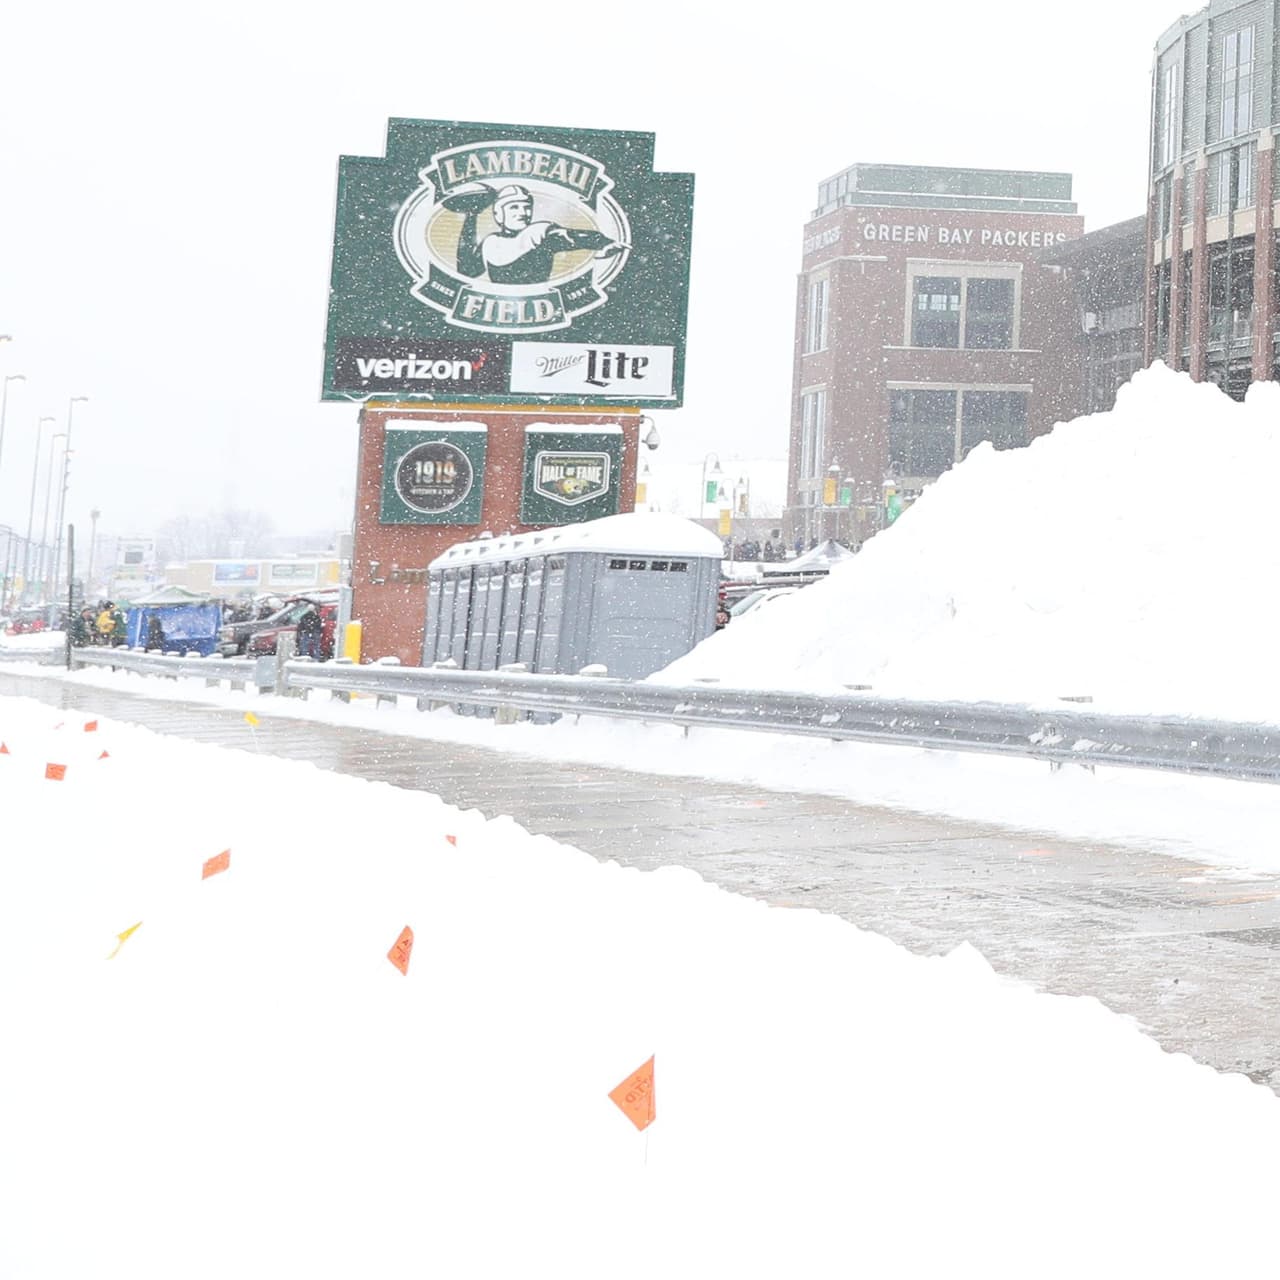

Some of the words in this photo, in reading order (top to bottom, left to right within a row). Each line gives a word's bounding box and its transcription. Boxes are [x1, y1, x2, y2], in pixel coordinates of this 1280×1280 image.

[444, 150, 592, 191] LAMBEAU
[863, 222, 929, 243] GREEN
[938, 226, 974, 245] BAY
[981, 229, 1067, 248] PACKERS
[462, 294, 555, 324] FIELD
[356, 353, 473, 381] verizon
[536, 353, 587, 378] Miller
[584, 349, 649, 388] Lite
[415, 460, 456, 484] 1919
[542, 465, 565, 483] HALL
[576, 466, 603, 484] FAME
